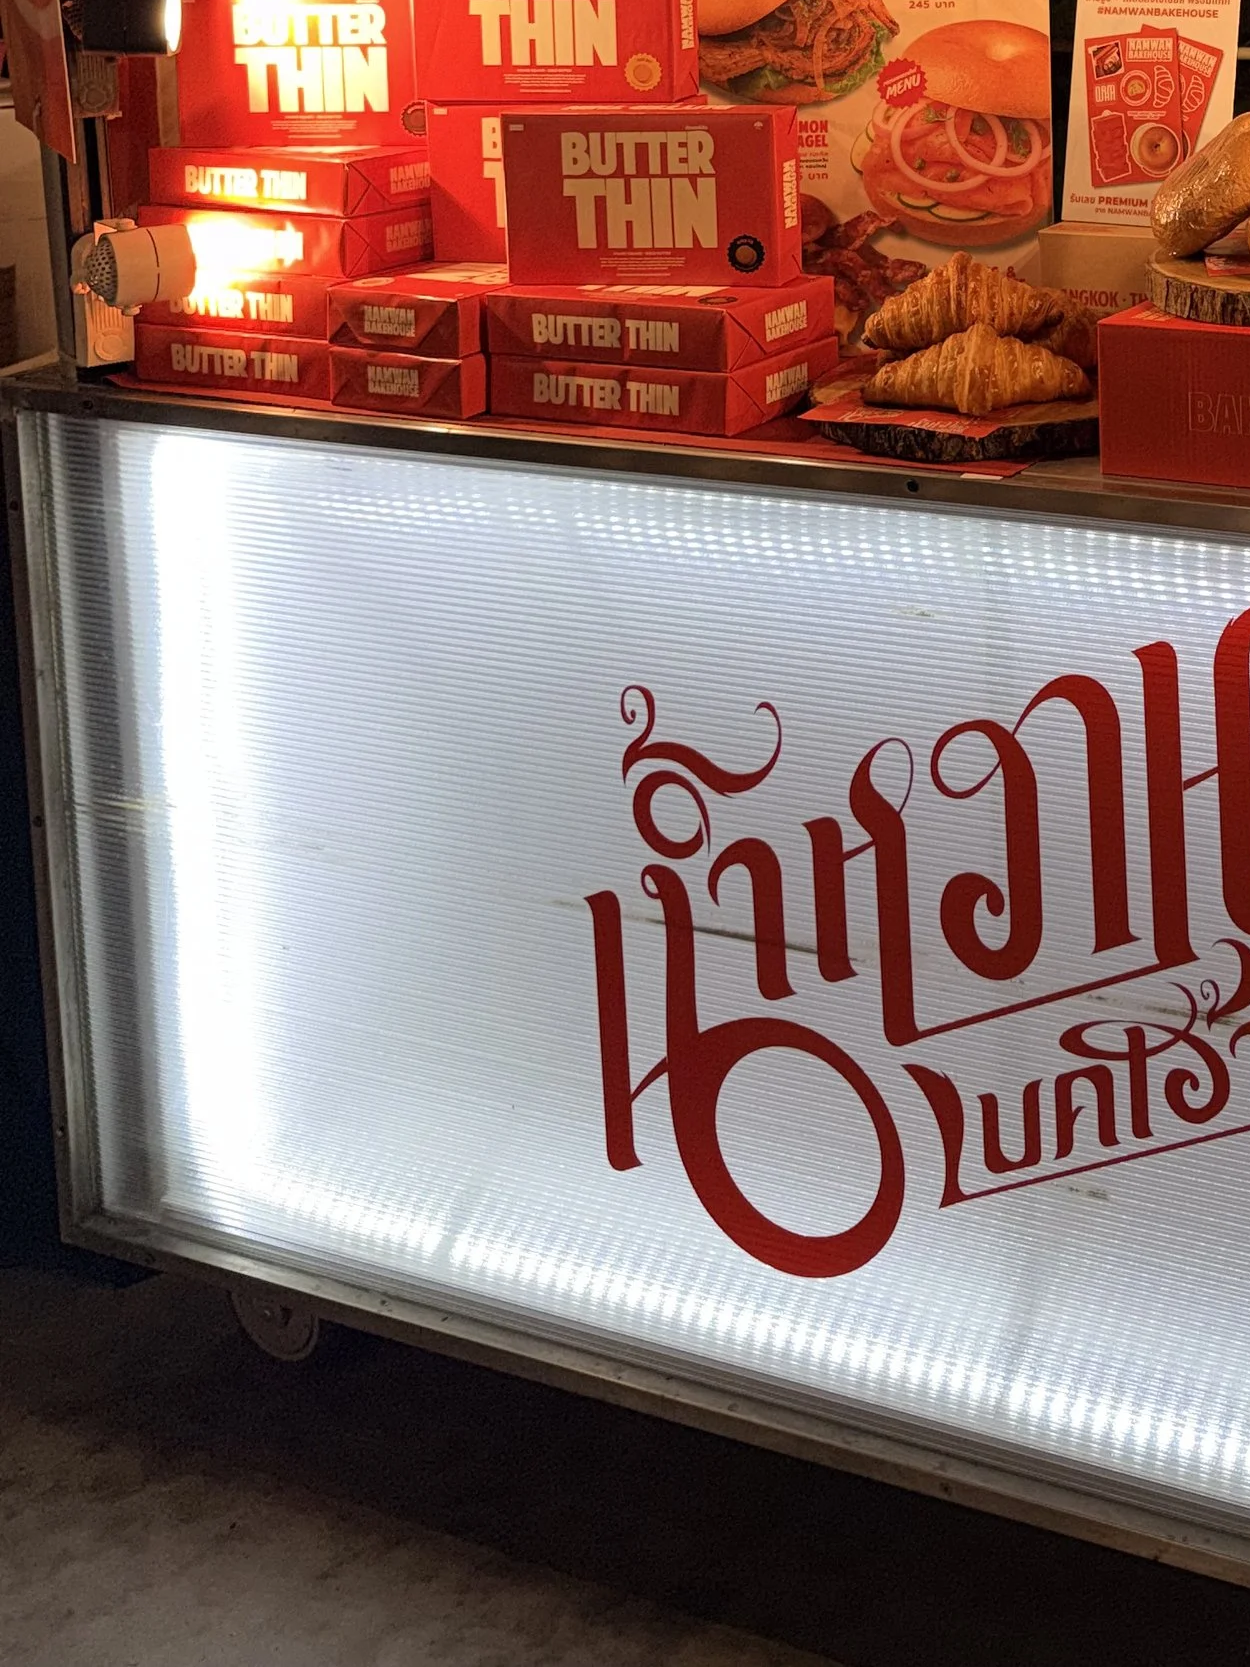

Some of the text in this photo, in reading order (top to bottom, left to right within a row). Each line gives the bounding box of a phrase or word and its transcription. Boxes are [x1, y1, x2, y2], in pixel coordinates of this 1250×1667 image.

[909, 0, 930, 9] 245
[1097, 7, 1219, 18] #NAMWANBAKEHOUSE
[232, 3, 387, 46] BUTTER
[1128, 39, 1172, 51] NAMWAN
[234, 46, 389, 113] THIN
[886, 73, 921, 99] MENU
[561, 130, 716, 176] BUTTER
[184, 165, 307, 201] BUTTER THIN
[563, 177, 718, 249] THIN
[1098, 196, 1148, 207] PREMIUM
[170, 287, 294, 323] BUTTER THIN
[363, 305, 415, 324] NAMWAN
[764, 300, 807, 329] NAMWAN
[364, 320, 416, 337] BAKEHOUSE
[532, 313, 679, 353] BUTTER THIN
[171, 343, 299, 383] BUTTER THIN
[367, 365, 419, 386] NAMWAN
[765, 362, 808, 392] NAMWAN
[367, 381, 420, 398] BAKEHOUSE
[533, 372, 679, 416] BUTTER THIN
